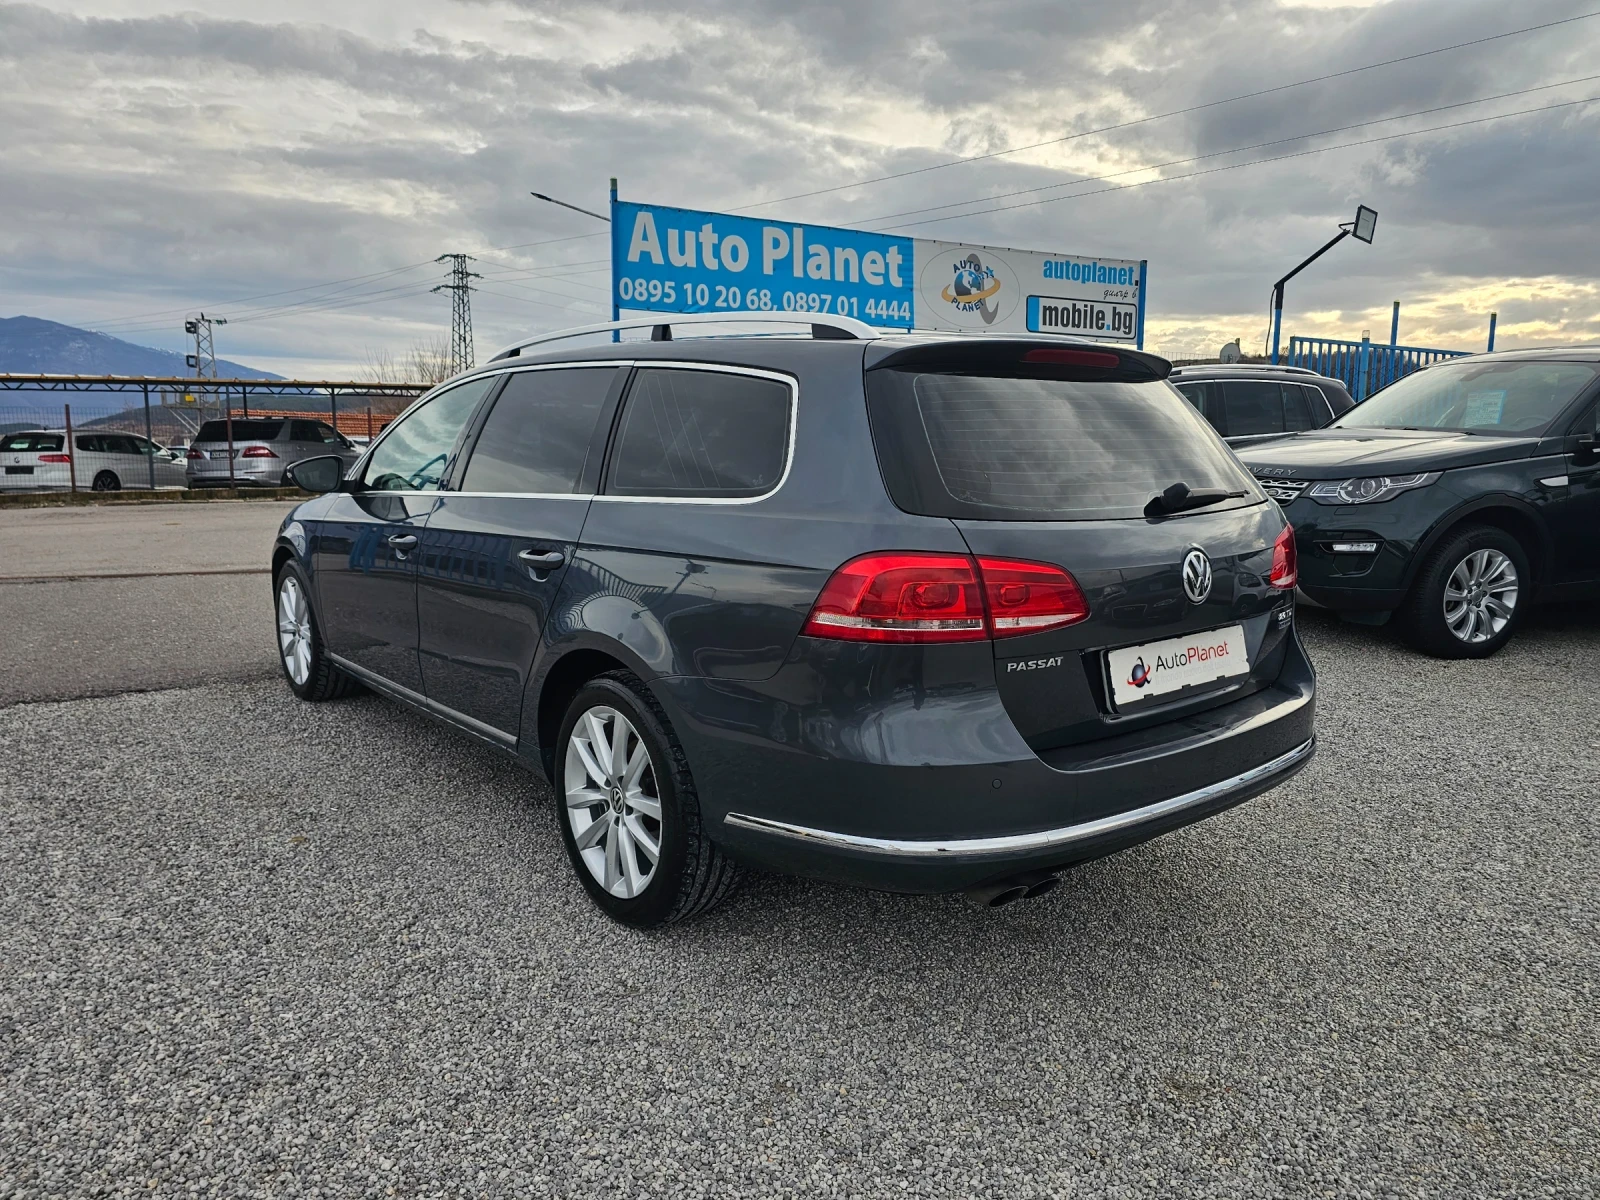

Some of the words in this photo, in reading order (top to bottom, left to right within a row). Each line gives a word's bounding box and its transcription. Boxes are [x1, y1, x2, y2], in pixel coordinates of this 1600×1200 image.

[627, 211, 750, 273] Auto
[762, 227, 903, 288] Planet
[953, 260, 981, 273] AUTO
[619, 277, 676, 303] 0895
[683, 283, 709, 306] 10
[715, 285, 741, 309] 20
[746, 288, 778, 311] 68,
[782, 291, 832, 313] 0897
[837, 295, 858, 317] 01
[865, 298, 911, 321] 4444
[951, 297, 984, 312] PLANET
[1042, 303, 1133, 335] mobile.bg
[1006, 656, 1064, 673] PASSAT
[1155, 641, 1229, 672] AutoPlanet
